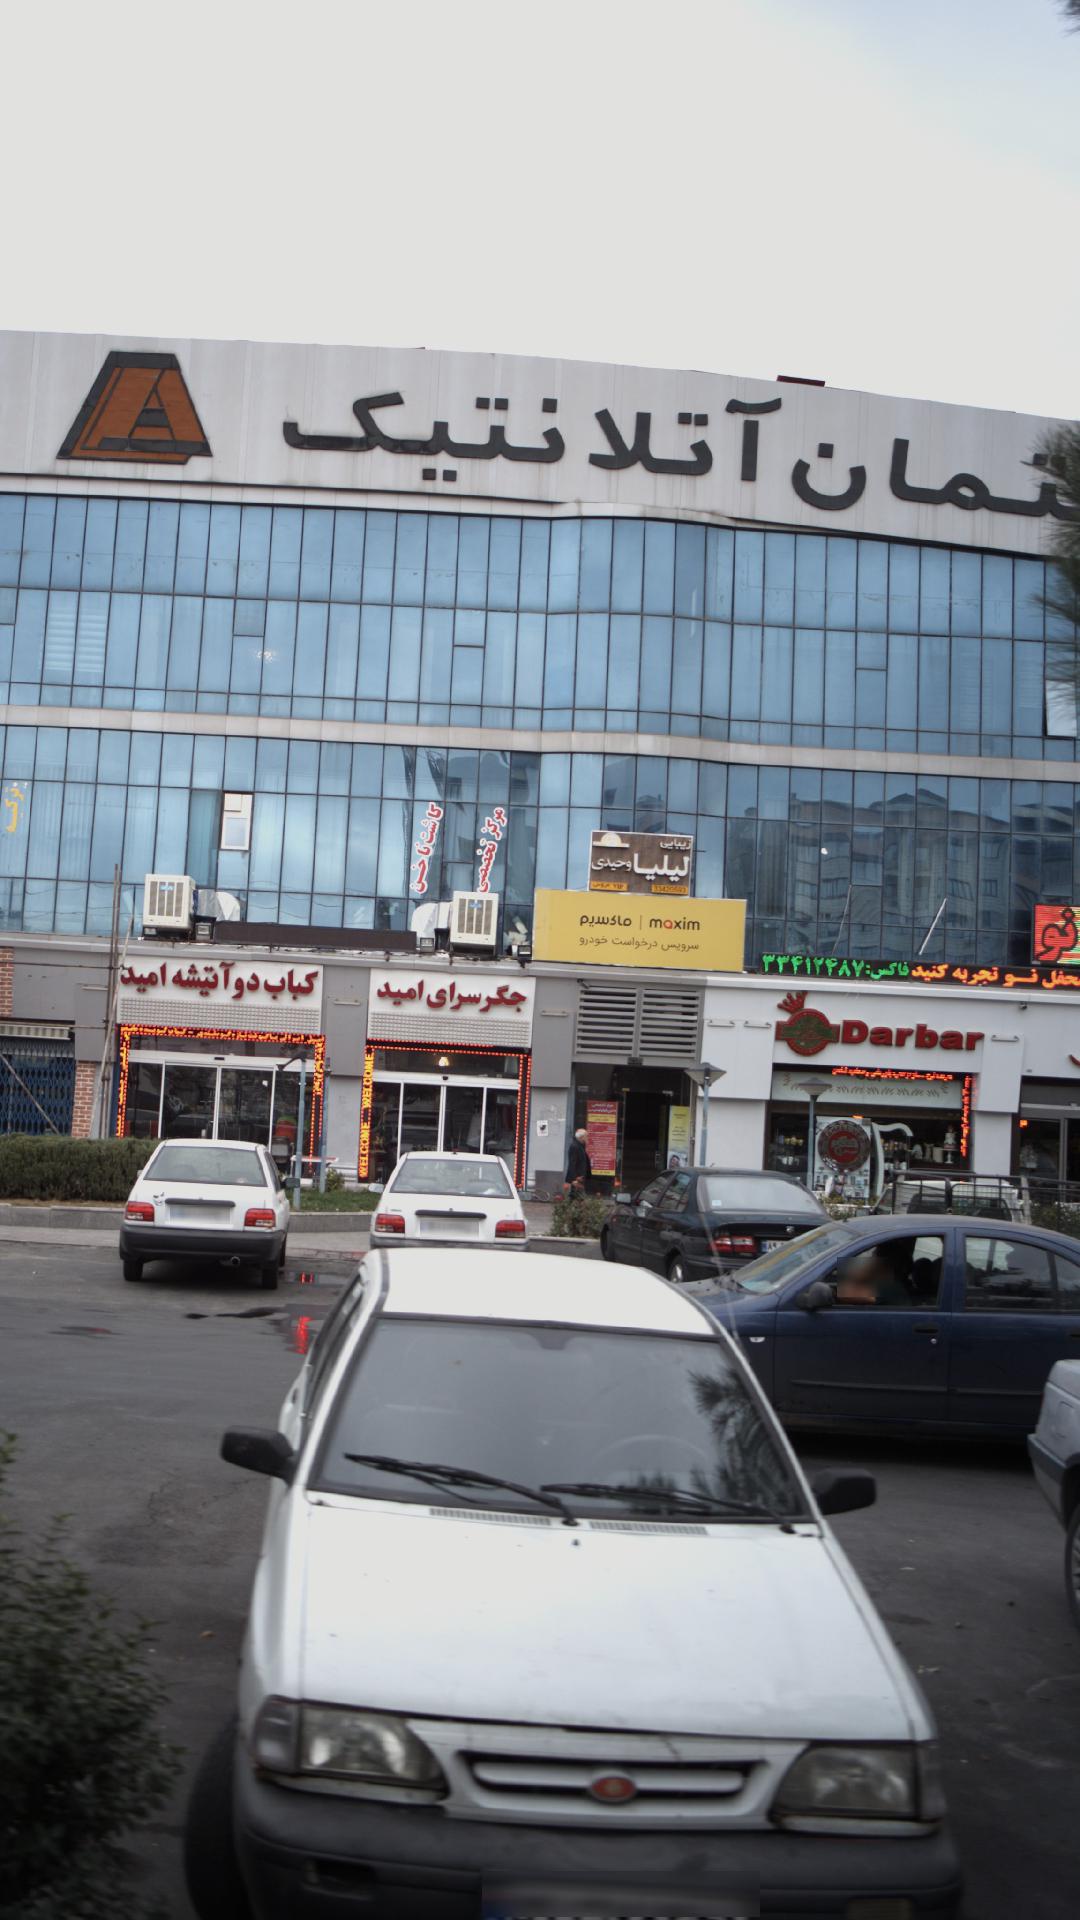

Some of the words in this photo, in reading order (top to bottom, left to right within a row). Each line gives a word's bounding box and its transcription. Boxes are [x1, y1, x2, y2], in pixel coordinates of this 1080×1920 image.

[283, 392, 782, 481] آتلانتیک
[420, 801, 444, 845] کاشت
[480, 807, 507, 841] مرکز
[659, 838, 692, 850] زیبایی
[591, 856, 633, 872] وحیدی
[632, 852, 690, 882] لیلیا
[579, 915, 632, 928] ماکسیم
[649, 916, 701, 931] maxim
[578, 935, 608, 946] خودرو
[611, 936, 658, 950] درخواست
[660, 942, 700, 952] سرویس
[119, 962, 167, 993] امید
[262, 968, 319, 1000] کباب
[911, 963, 949, 982] کنید
[951, 966, 999, 986] تجربه
[376, 979, 425, 1006] امید
[841, 1019, 985, 1051] Darbar
[362, 1052, 375, 1109] WELCOME
[359, 1121, 371, 1179] WELCOME
